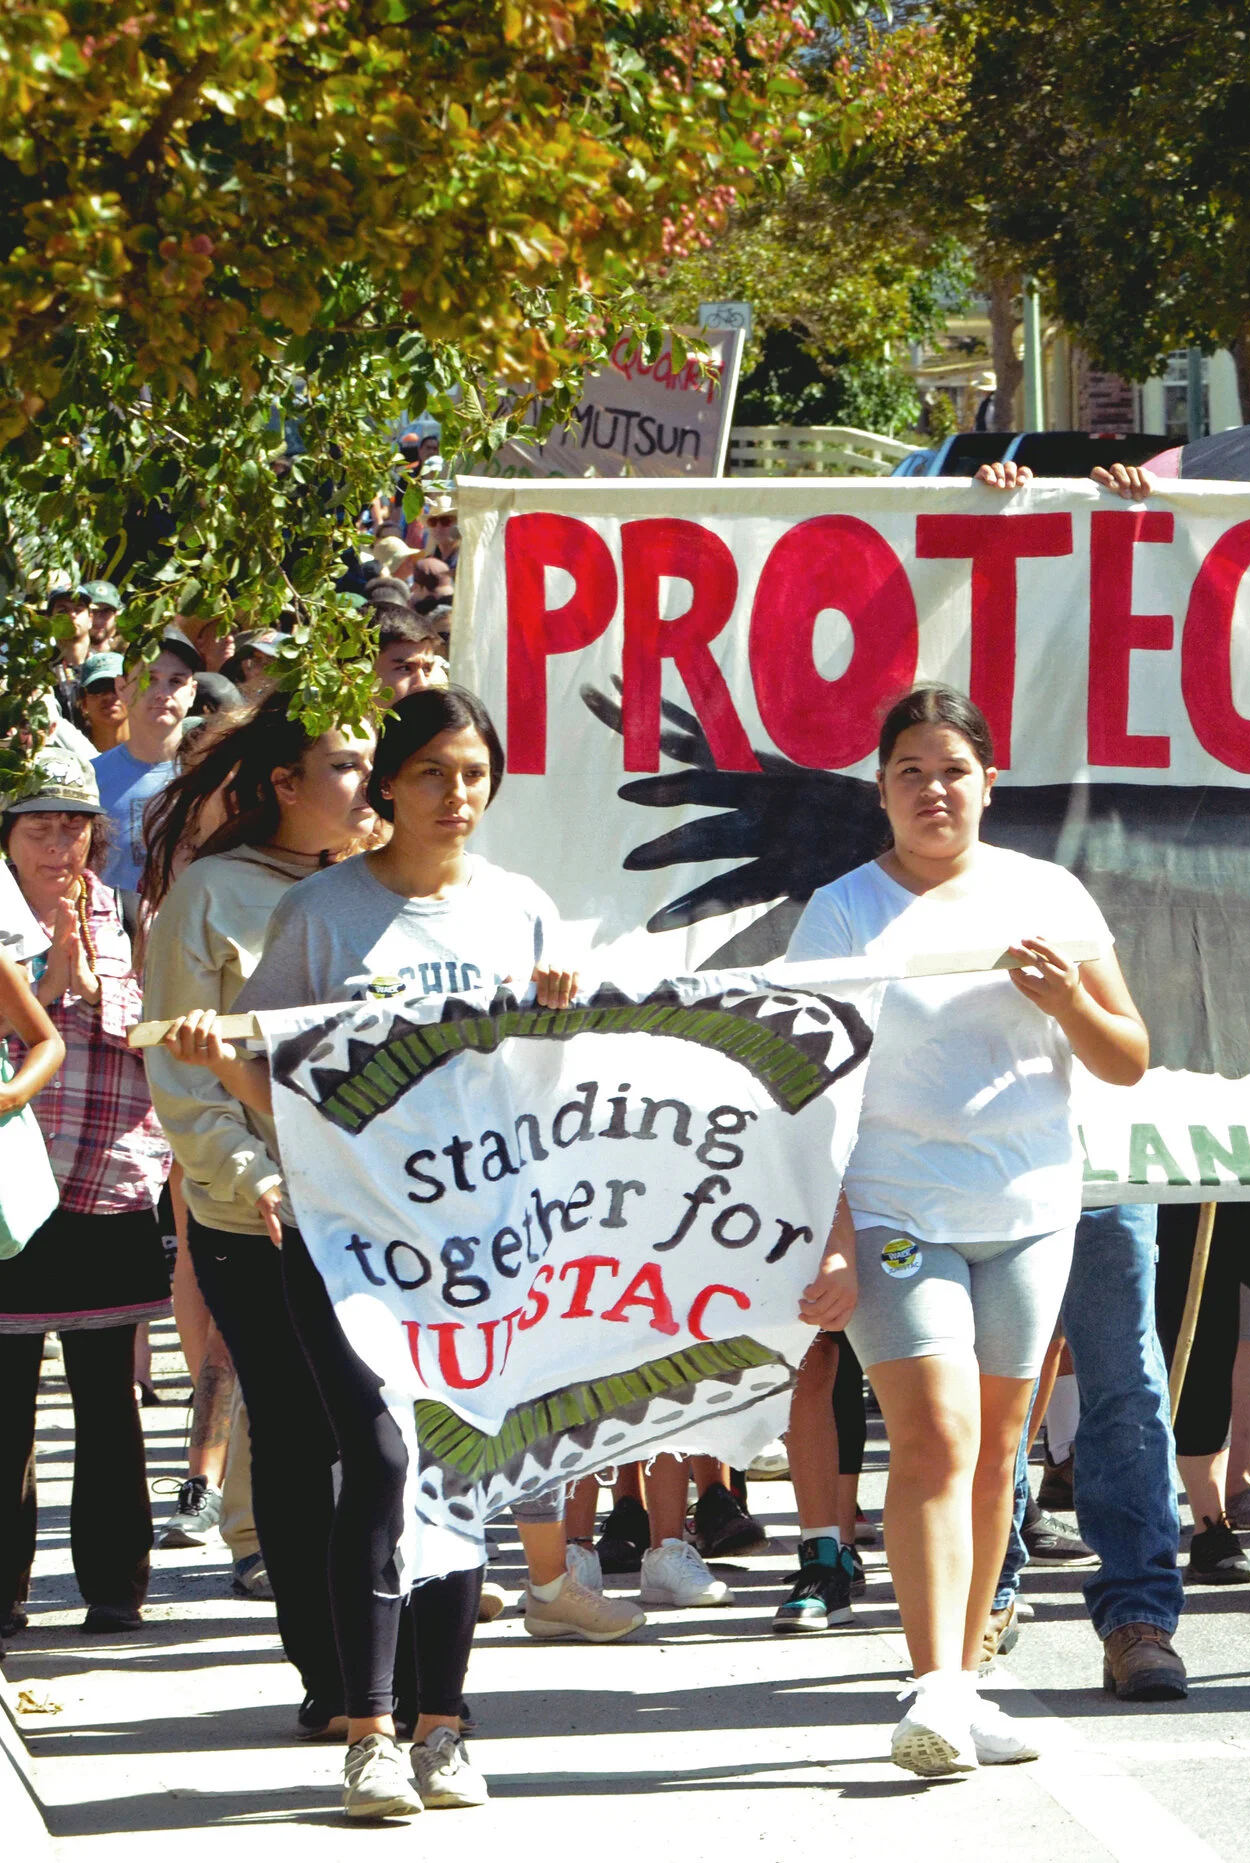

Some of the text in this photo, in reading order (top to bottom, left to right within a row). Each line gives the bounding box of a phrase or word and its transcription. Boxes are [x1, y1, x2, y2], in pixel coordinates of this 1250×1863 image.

[404, 1080, 758, 1204] standing
[345, 1174, 814, 1308] together for
